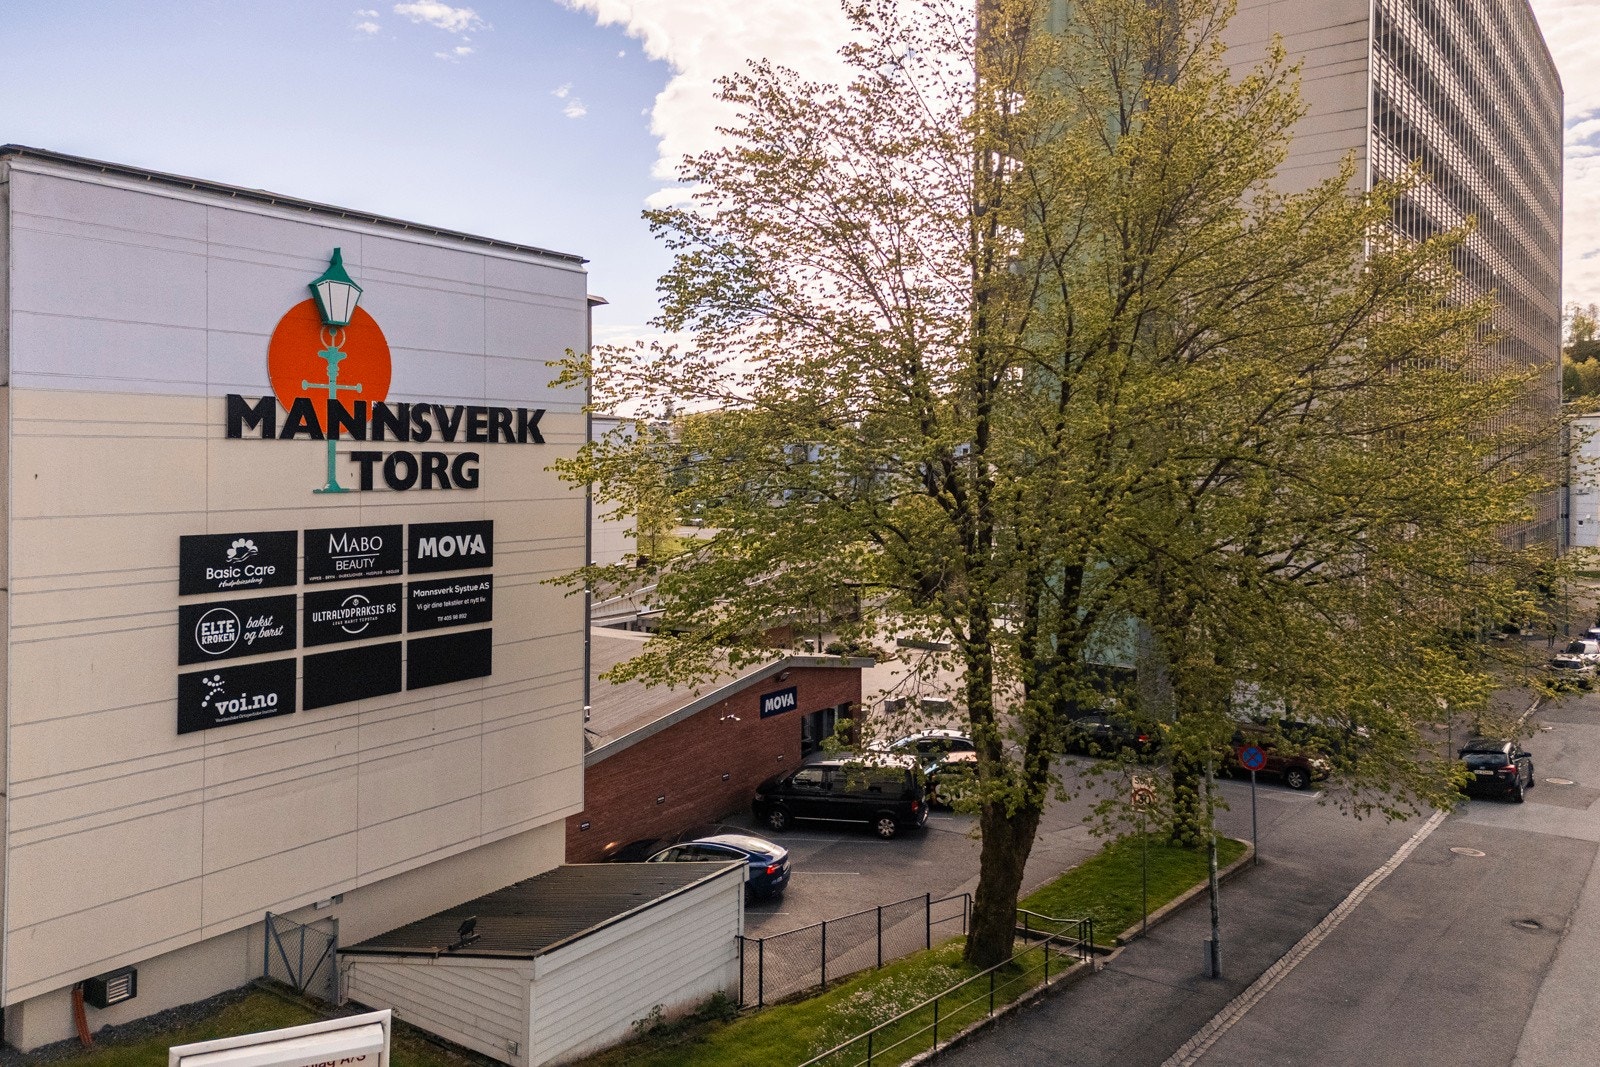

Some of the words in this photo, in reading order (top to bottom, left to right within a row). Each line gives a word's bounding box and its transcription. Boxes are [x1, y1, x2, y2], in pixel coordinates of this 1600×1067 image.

[226, 394, 545, 443] MANNSVERK
[351, 451, 479, 491] TORG
[418, 534, 486, 558] MOVA
[336, 558, 375, 570] BEAUTY
[206, 566, 240, 580] Basic
[244, 565, 276, 576] Care
[413, 586, 454, 598] Mannsverk
[454, 584, 478, 594] Systue
[312, 604, 384, 622] ULTRALYDPRAKSIS
[386, 603, 396, 613] AS
[202, 620, 235, 636] ELTE
[246, 616, 273, 628] bakst
[202, 632, 235, 645] KROKEN
[244, 632, 257, 645] og
[215, 693, 278, 714] voi.no
[764, 692, 794, 712] MOVA
